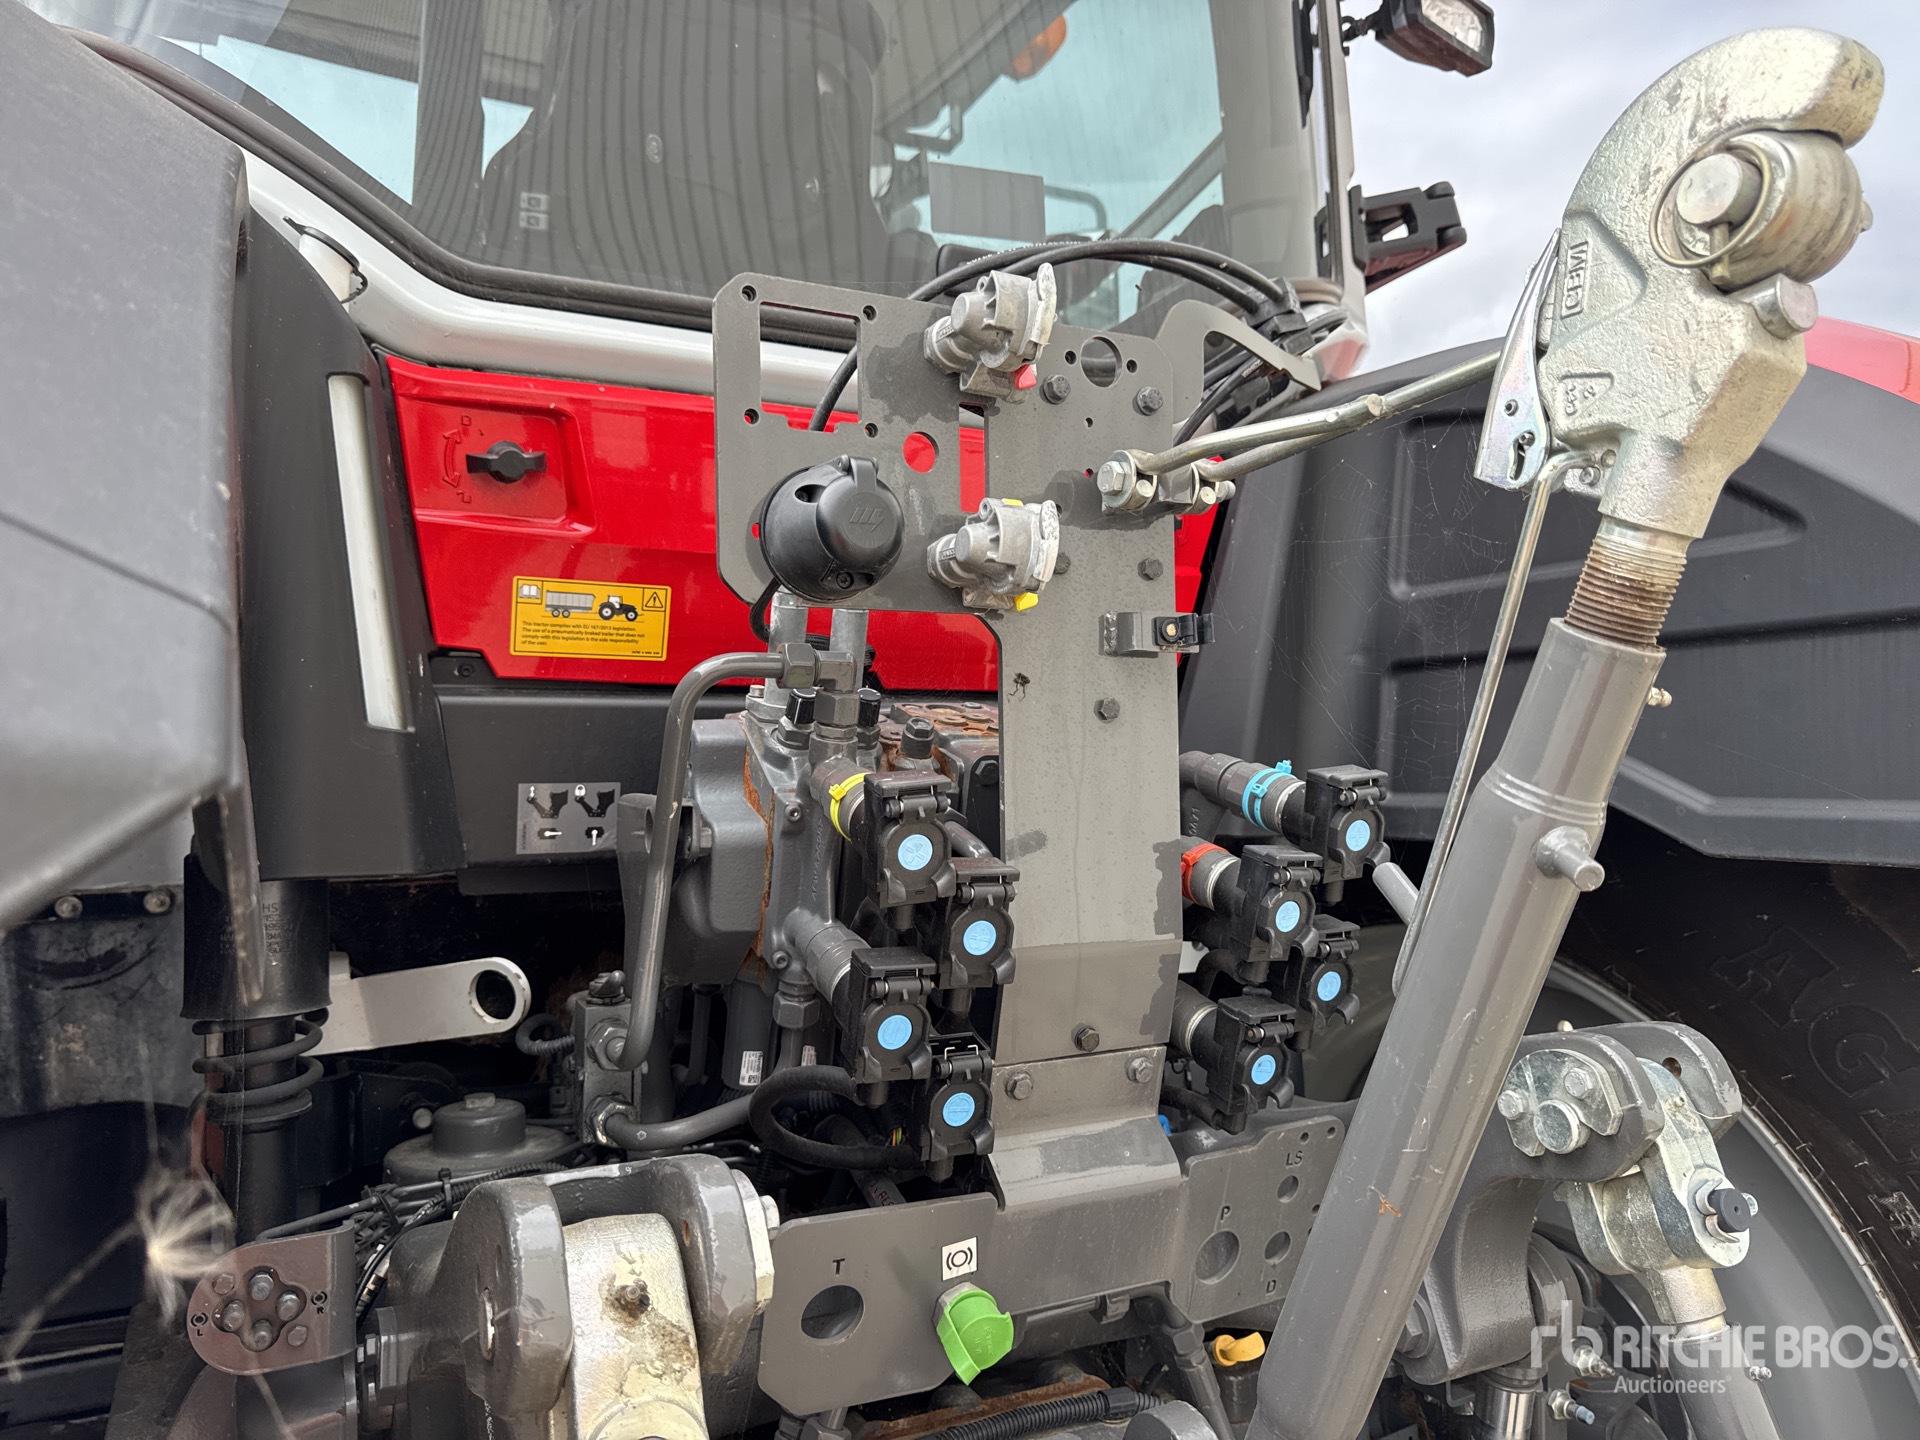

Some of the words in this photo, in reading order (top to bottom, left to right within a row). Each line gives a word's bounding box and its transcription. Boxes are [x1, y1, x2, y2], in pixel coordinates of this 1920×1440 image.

[1286, 1150, 1303, 1166] LS
[1220, 1205, 1231, 1220] P
[832, 1258, 845, 1275] T
[1266, 1280, 1277, 1293] D
